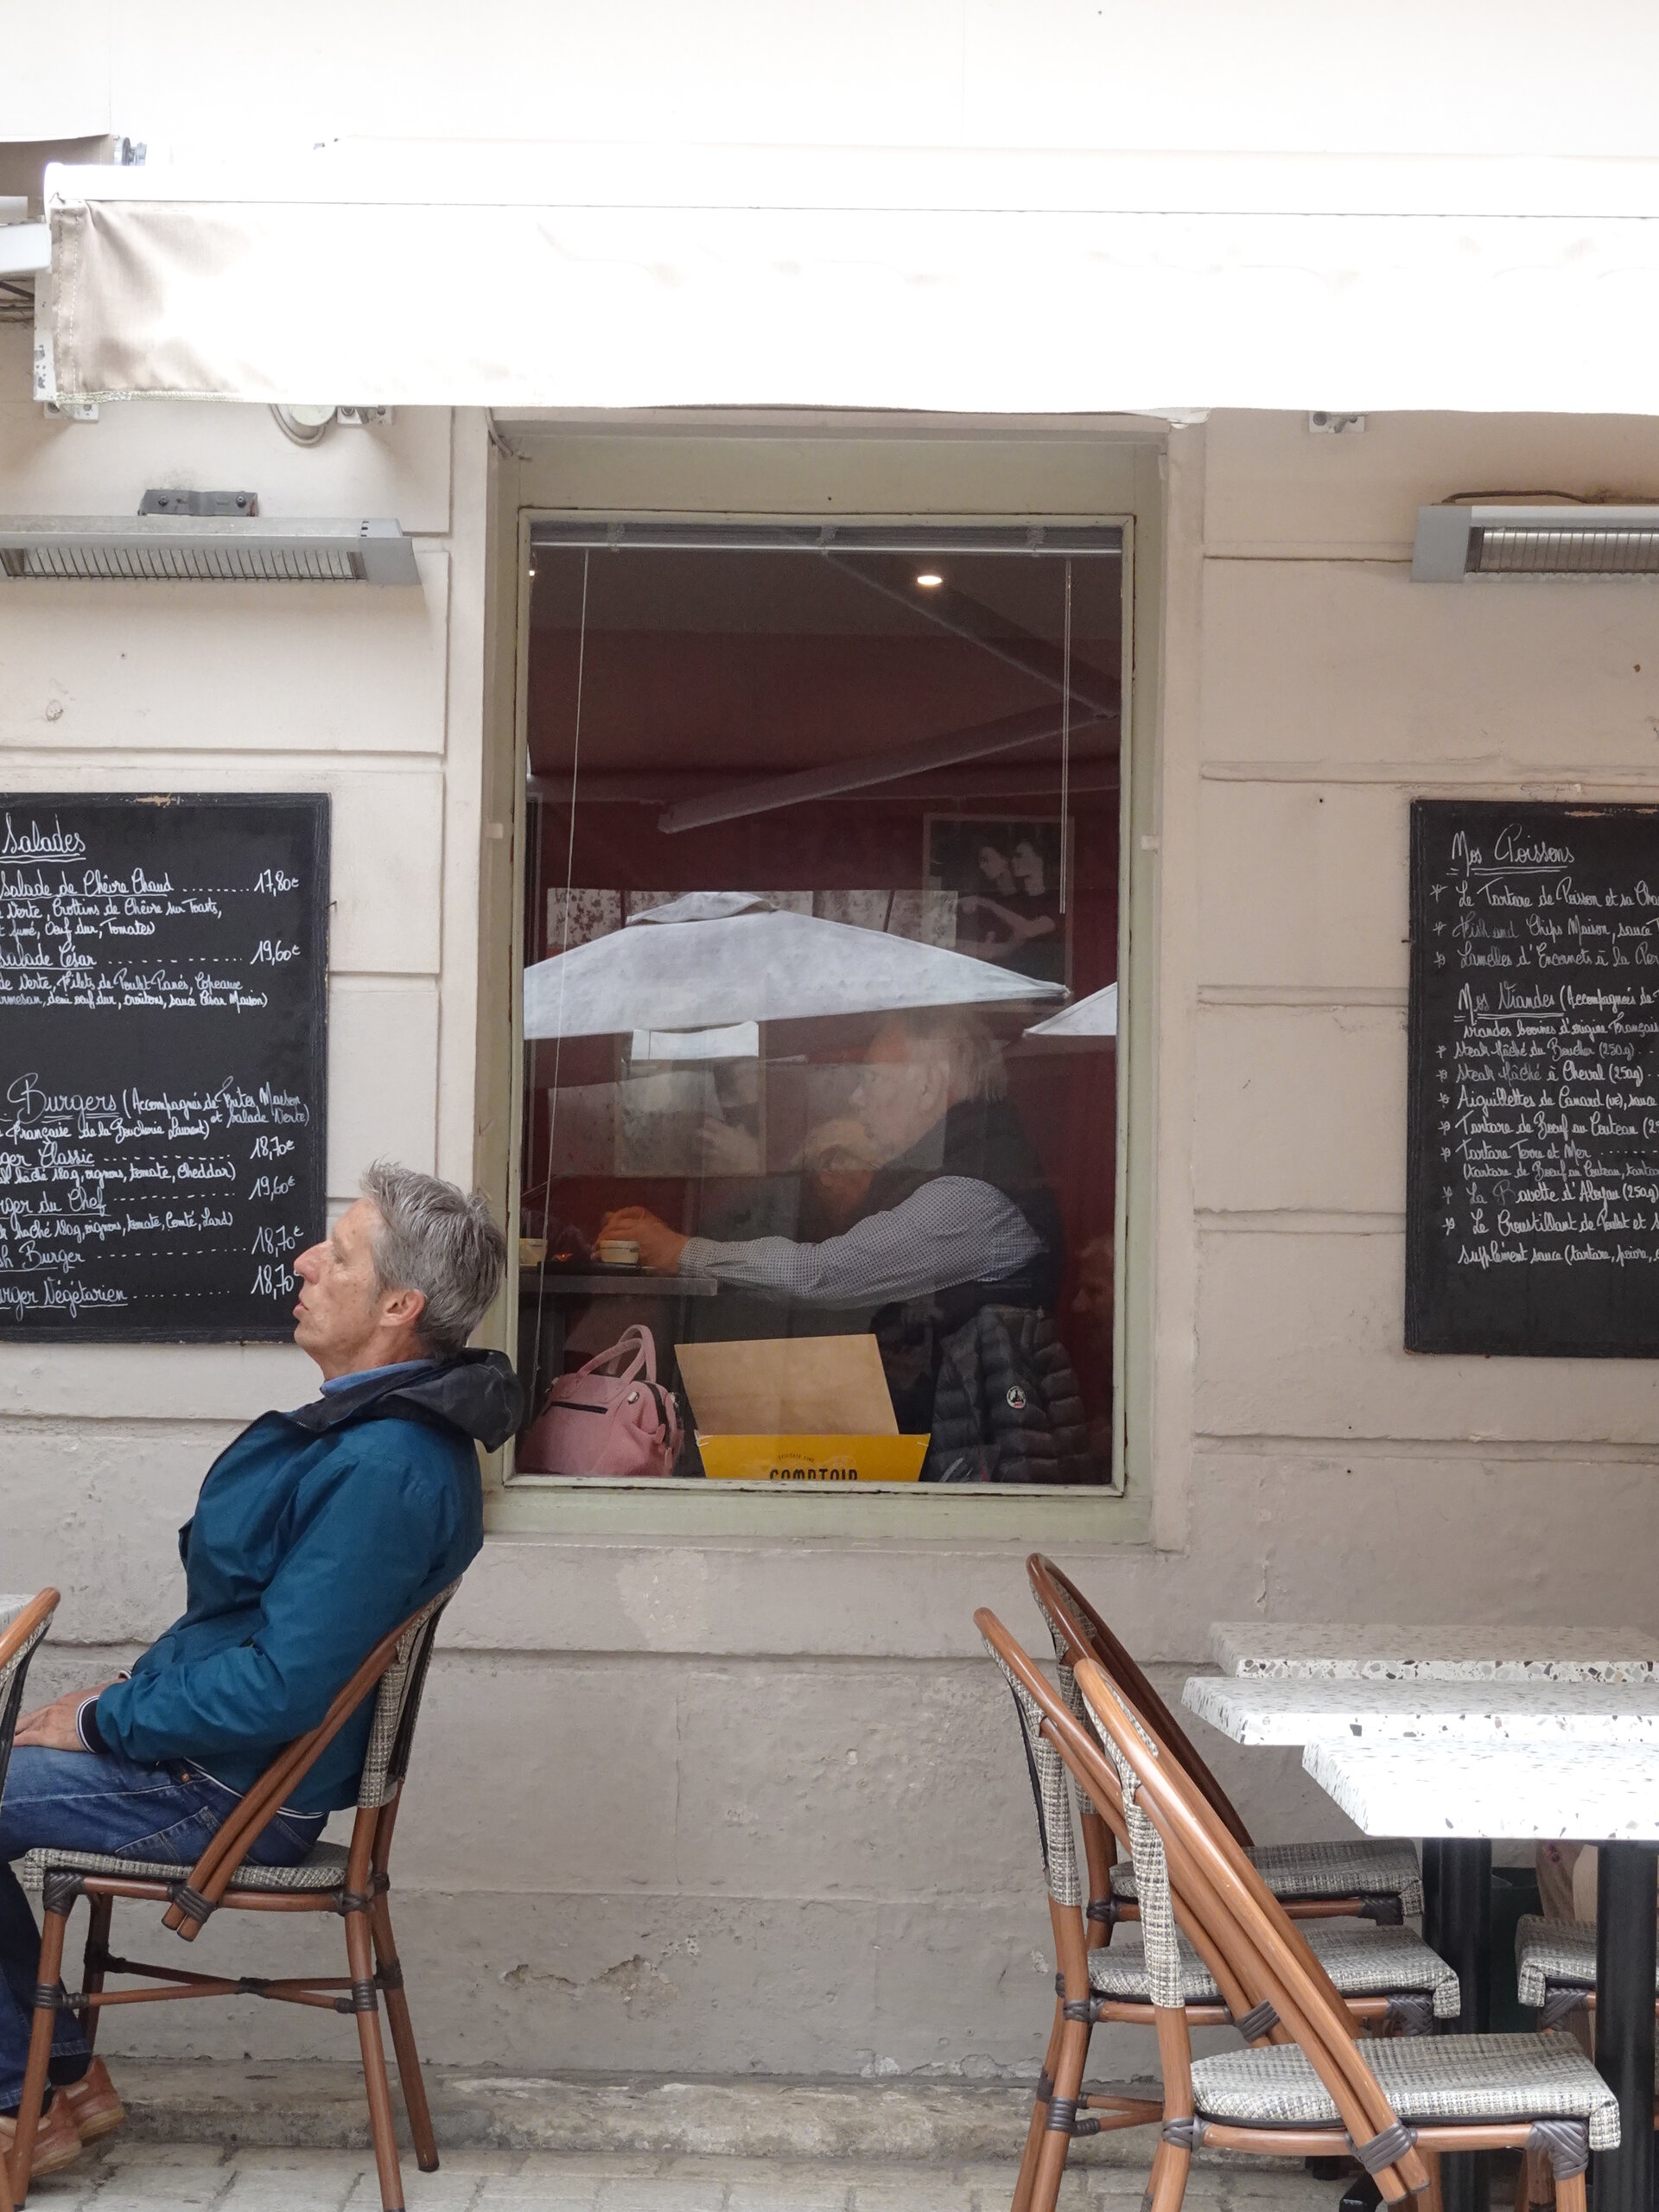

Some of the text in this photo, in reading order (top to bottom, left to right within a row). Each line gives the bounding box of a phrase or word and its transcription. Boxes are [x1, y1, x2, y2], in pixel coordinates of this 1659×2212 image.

[2, 812, 86, 854] Salades
[1494, 823, 1574, 863] Poissons
[0, 869, 52, 899] Salade
[56, 871, 78, 897] de
[132, 868, 175, 893] Chaud
[254, 868, 300, 897] 17,80€
[1455, 880, 1475, 906] Le
[1477, 877, 1533, 907] Tartare
[1538, 885, 1554, 907] de
[1556, 876, 1602, 907] Poisson
[1605, 887, 1618, 906] et
[1619, 893, 1635, 907] sa
[103, 898, 120, 916] de
[166, 901, 185, 915] sur
[75, 918, 103, 938] dur,
[1452, 911, 1491, 939] Fish
[1492, 920, 1519, 939] and
[1526, 913, 1562, 944] Chips
[1617, 922, 1652, 938] sauce
[59, 942, 97, 967] César
[250, 940, 301, 965] 19,60€
[1457, 941, 1512, 968] Lamelles
[1596, 950, 1608, 966] à
[1612, 946, 1630, 967] la
[97, 973, 115, 990] de
[113, 968, 150, 990] Poulet
[47, 991, 73, 1006] demi
[96, 991, 121, 1009] dur,
[168, 994, 197, 1007] sauce
[1498, 981, 1555, 1009] Viandes
[1640, 986, 1655, 1006] de
[1516, 1019, 1556, 1037] bovines
[1529, 1039, 1546, 1057] du
[1547, 1065, 1559, 1081] à
[1563, 1059, 1605, 1082] Cheval
[7, 1072, 118, 1133] Burgers
[202, 1092, 219, 1111] de
[259, 1081, 301, 1116] Maison
[1457, 1084, 1535, 1117] Aiguillettes
[1538, 1089, 1555, 1107] de
[1559, 1085, 1605, 1109] Canard
[79, 1122, 97, 1139] de
[99, 1121, 111, 1137] la
[110, 1117, 165, 1144] Boucherie
[211, 1110, 223, 1123] et
[1454, 1109, 1514, 1135] Tartare
[1516, 1114, 1534, 1134] de
[1534, 1110, 1568, 1141] Boeuf
[1572, 1124, 1588, 1133] au
[1590, 1111, 1638, 1136] Couteau
[38, 1141, 95, 1166] Classic
[250, 1135, 296, 1160] 18,70€
[1455, 1138, 1592, 1166] Tartare Terre et Mer
[1515, 1160, 1530, 1179] de
[1532, 1160, 1567, 1182] Boeuf
[38, 1191, 62, 1213] du
[67, 1186, 106, 1217] Chef
[249, 1175, 296, 1201] 19,60€
[1465, 1182, 1487, 1205] La
[15, 1219, 52, 1240] haché
[165, 1211, 201, 1231] Comté,
[200, 1207, 233, 1227] Lard)
[1471, 1208, 1489, 1235] Le
[1497, 1209, 1577, 1236] Croustillant
[1579, 1212, 1596, 1232] de
[1597, 1208, 1630, 1231] Poulet
[1632, 1212, 1646, 1230] et
[18, 1240, 86, 1274] Burger
[251, 1225, 303, 1257] 18,70€
[1529, 1248, 1562, 1264] sauce
[43, 1277, 128, 1319] Végétarien
